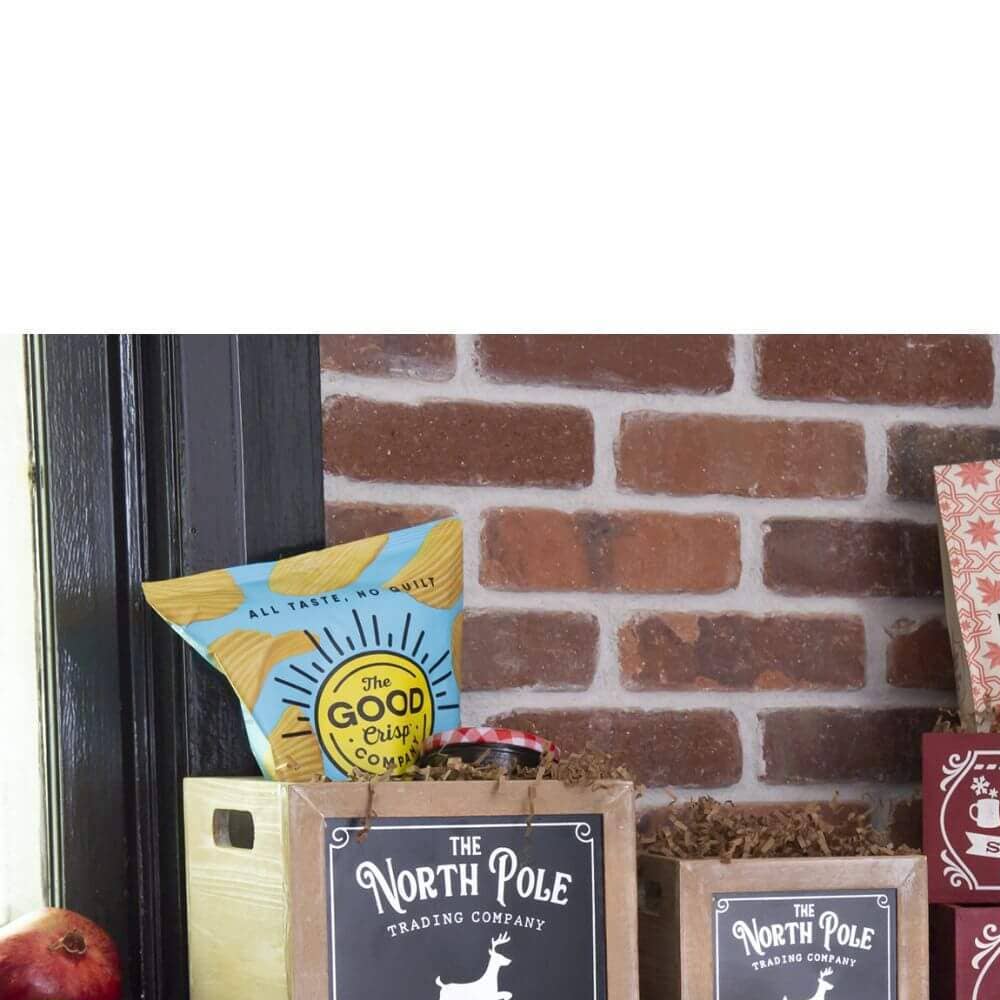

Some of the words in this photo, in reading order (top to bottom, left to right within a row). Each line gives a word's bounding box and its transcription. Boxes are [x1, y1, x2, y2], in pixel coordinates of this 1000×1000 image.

[249, 605, 280, 619] ALL
[288, 594, 349, 611] TASTE,
[356, 588, 380, 598] NO
[362, 676, 392, 691] The
[328, 687, 424, 729] GOOD
[362, 724, 411, 745] Crisp
[355, 735, 420, 769] COMPANY
[449, 836, 482, 856] THE
[356, 858, 479, 914] NORTH
[488, 847, 573, 907] POLE
[793, 903, 815, 918] THE
[387, 912, 464, 937] TRADING
[471, 911, 546, 932] COMPANY
[732, 918, 813, 956] NORTH
[819, 910, 875, 951] POLE
[752, 953, 803, 970] TRADING
[807, 953, 857, 967] COMPANY
